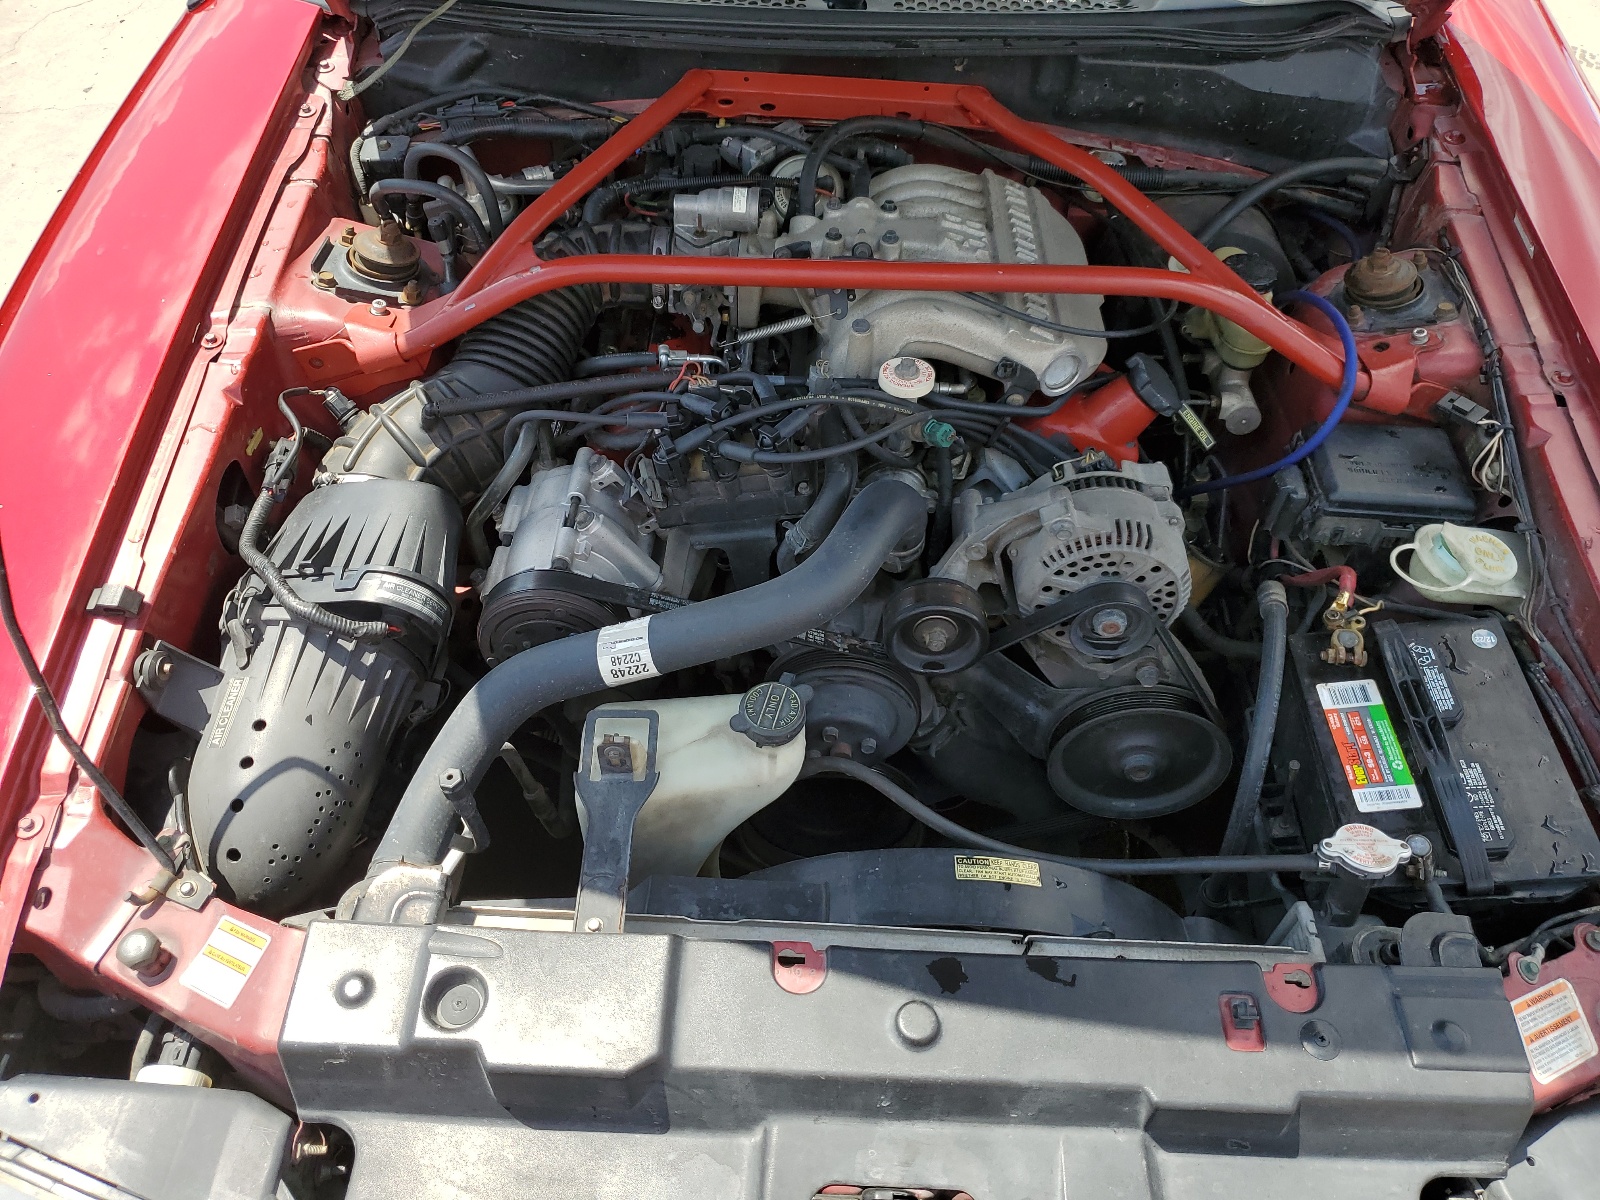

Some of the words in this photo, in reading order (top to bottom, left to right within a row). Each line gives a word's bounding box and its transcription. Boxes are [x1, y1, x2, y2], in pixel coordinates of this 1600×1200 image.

[1183, 409, 1202, 432] ENGINE
[1200, 431, 1208, 442] OIL
[383, 581, 395, 590] AIR
[396, 585, 426, 601] CLEANER
[610, 652, 641, 666] C2248
[610, 663, 649, 679] 22248
[212, 727, 225, 745] AIR
[219, 679, 244, 725] CLEANER
[746, 688, 763, 717] COOLANT
[764, 694, 780, 719] ONLY
[779, 694, 799, 726] RADIATOR
[1530, 990, 1554, 1006] WARNING
[1534, 1015, 1573, 1039] AVERTISSEMENT
